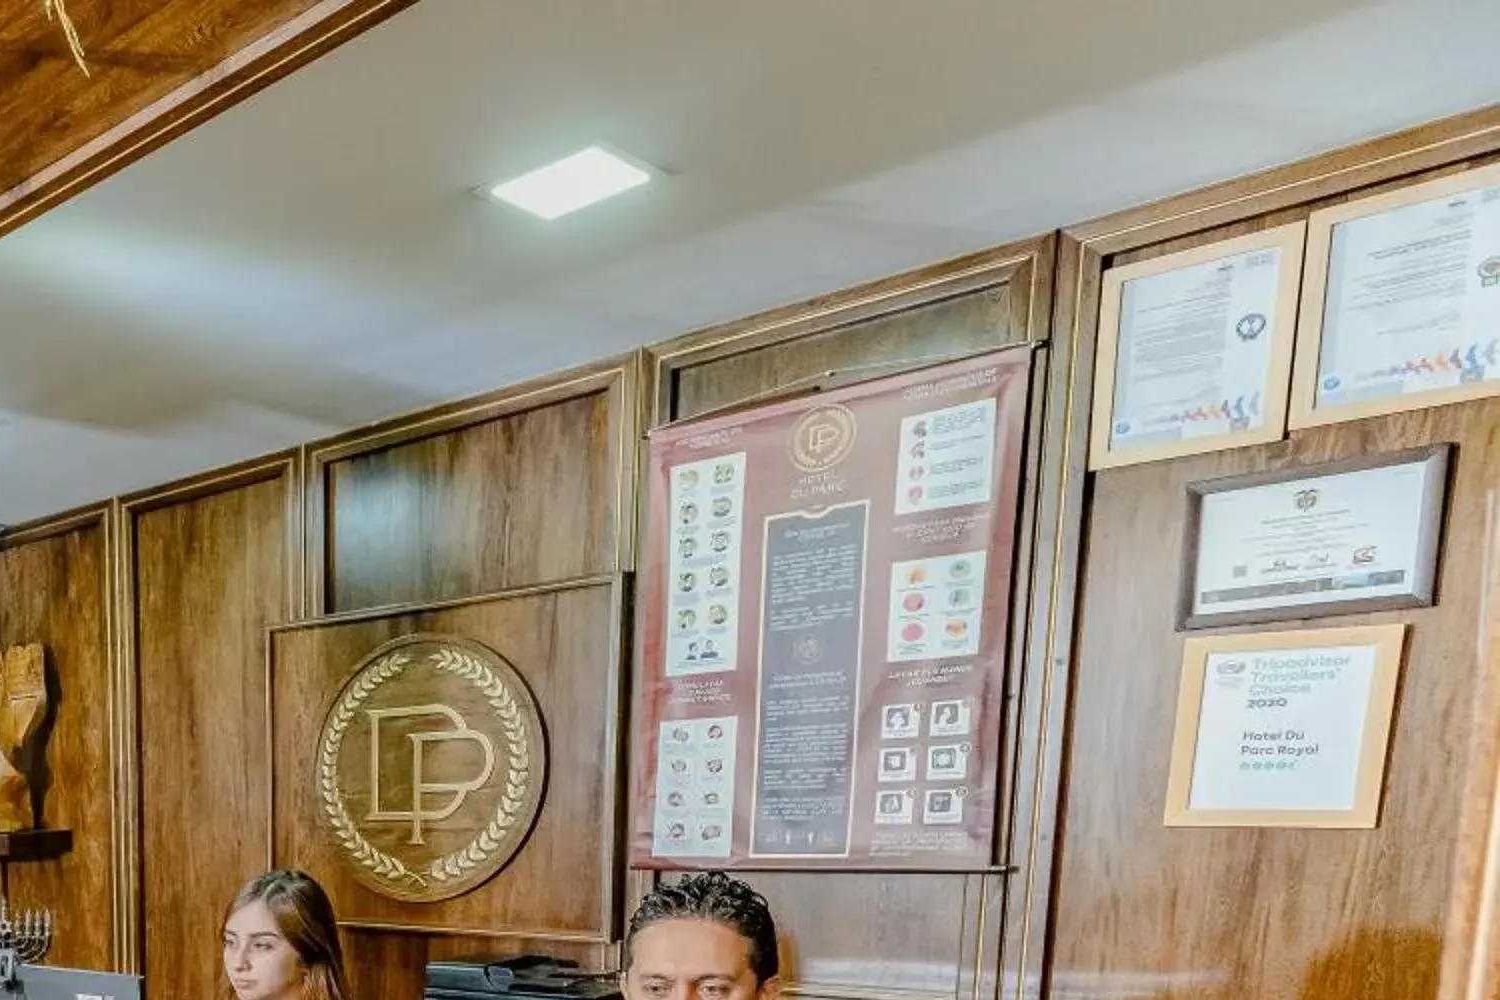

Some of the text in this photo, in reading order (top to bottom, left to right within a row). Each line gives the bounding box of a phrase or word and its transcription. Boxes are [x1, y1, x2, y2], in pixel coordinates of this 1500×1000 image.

[1251, 656, 1351, 670] Tripadvisor
[1246, 697, 1288, 709] 2020
[1243, 730, 1305, 741] Hotel Du
[1240, 744, 1319, 757] Parc Royal
